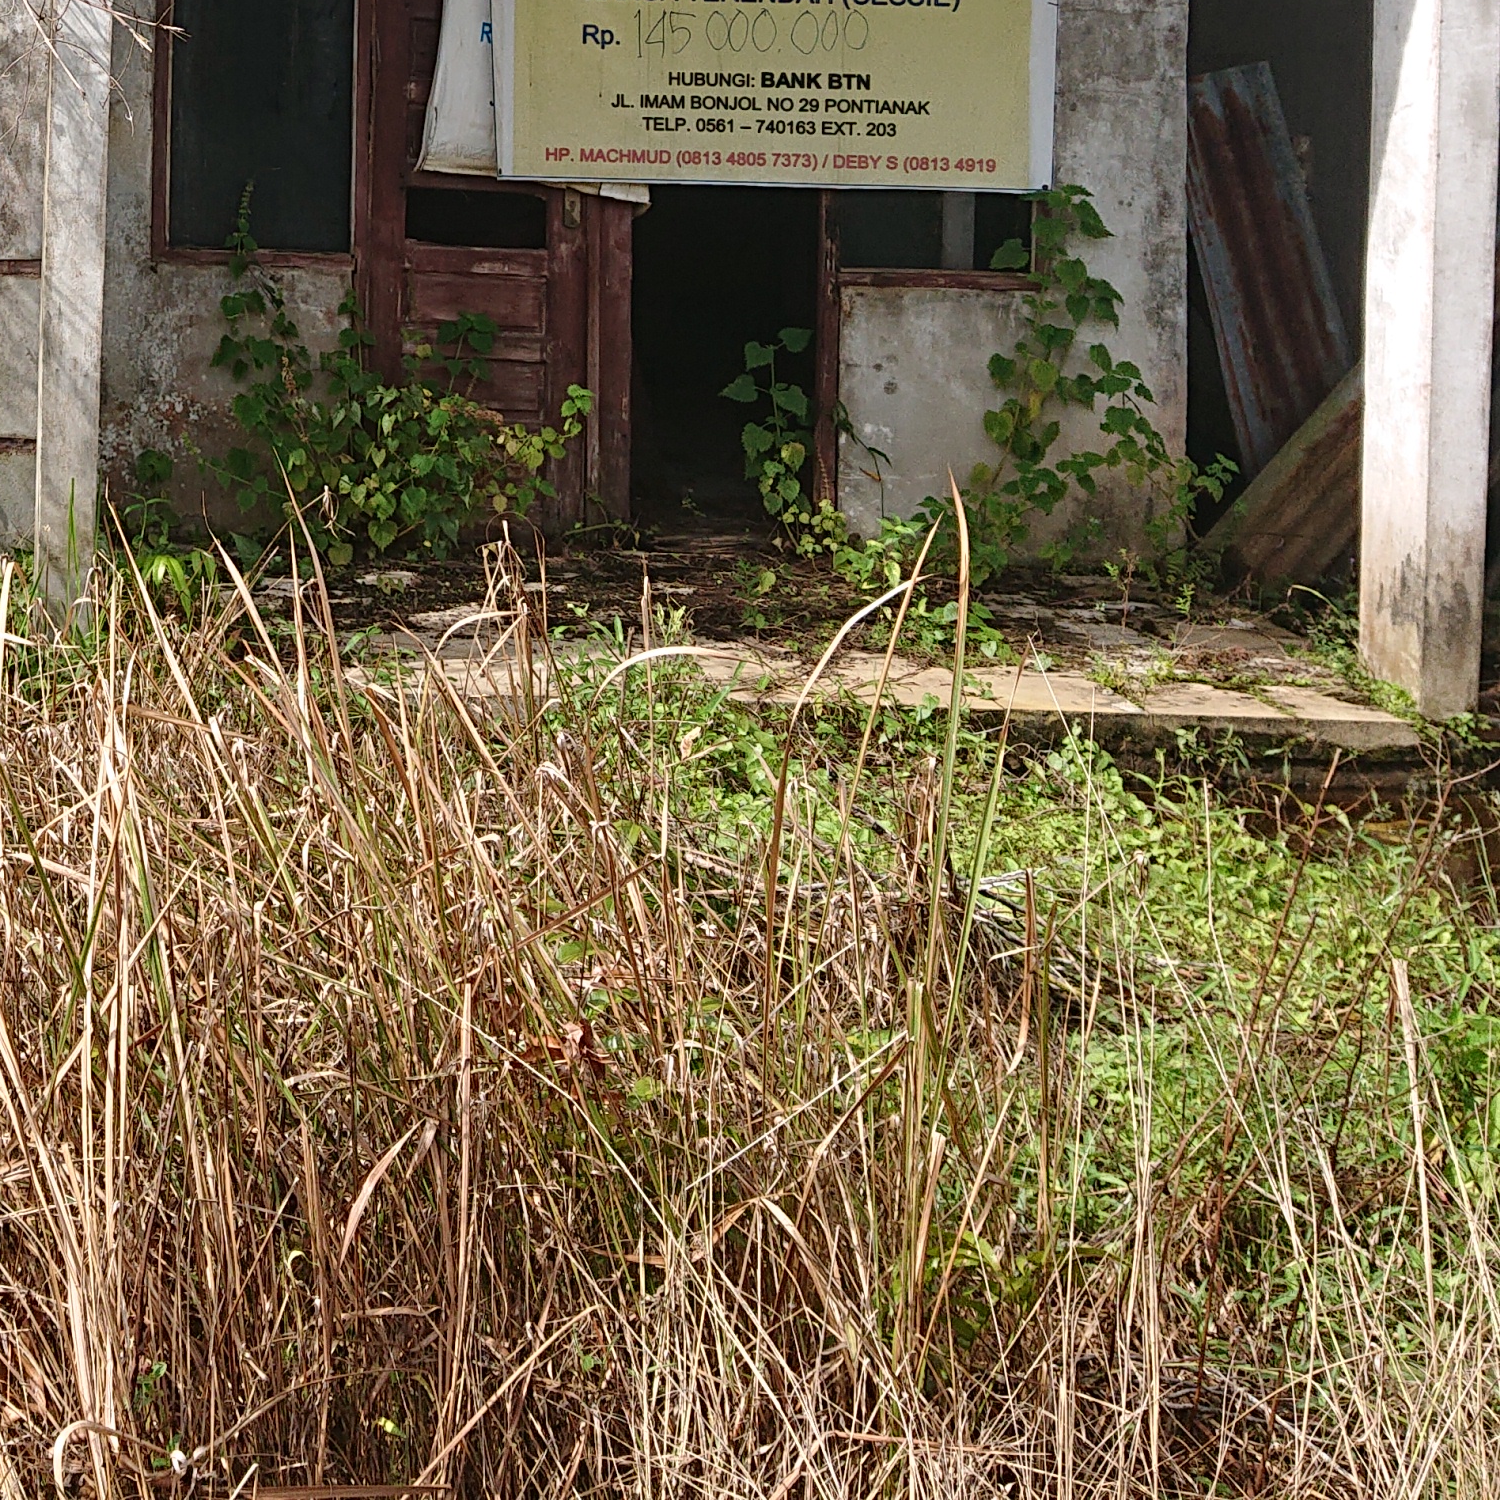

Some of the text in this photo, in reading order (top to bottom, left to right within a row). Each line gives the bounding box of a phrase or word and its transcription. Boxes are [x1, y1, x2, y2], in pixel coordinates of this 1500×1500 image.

[480, 22, 492, 44] R
[582, 24, 621, 49] Rp.
[668, 71, 871, 91] HUBUNGI: BANK BTN
[611, 94, 931, 116] JL. IMAM BONJOL NO 29 PONTIANAK
[642, 116, 691, 132] TELP.
[695, 118, 734, 133] 0561
[755, 119, 817, 135] 740163
[821, 121, 861, 136] EXT.
[865, 122, 897, 137] 203
[545, 147, 575, 162] HP.
[579, 148, 671, 165] MACHMUD
[676, 150, 722, 168] (0813
[725, 152, 767, 167] 4805
[771, 153, 819, 171] 7373)
[832, 154, 883, 170] DEBY
[885, 155, 899, 170] S
[903, 156, 950, 174] (0813
[954, 157, 997, 173] 4919
